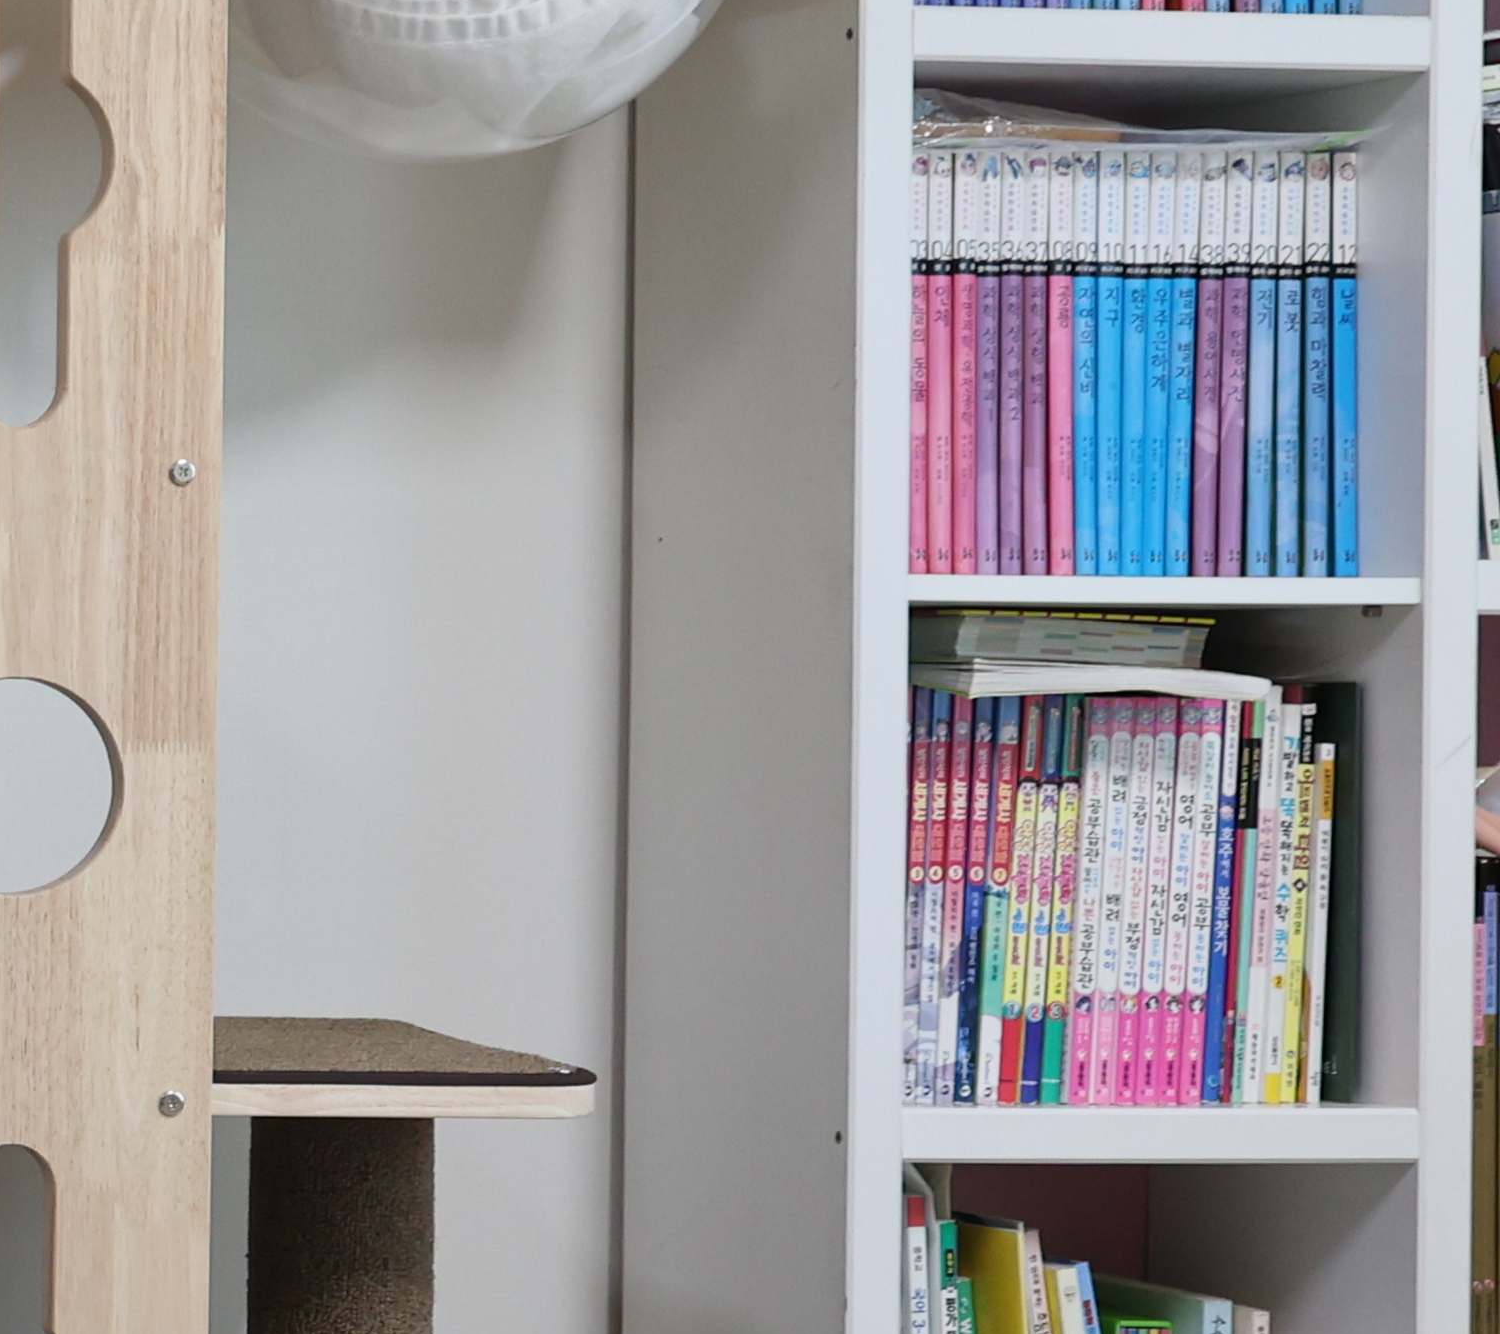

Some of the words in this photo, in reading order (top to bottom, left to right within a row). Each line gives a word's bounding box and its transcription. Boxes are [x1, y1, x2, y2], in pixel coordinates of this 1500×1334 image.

[1110, 774, 1128, 805] 배려
[1154, 780, 1174, 833] 자신감
[1177, 794, 1196, 829] 영어
[1198, 802, 1217, 835] 공부
[1104, 893, 1123, 923] 배려
[1149, 884, 1168, 937] 자신감
[1171, 892, 1190, 928] 영어
[1194, 897, 1212, 930] 공부
[1211, 885, 1229, 957] 보물찾기
